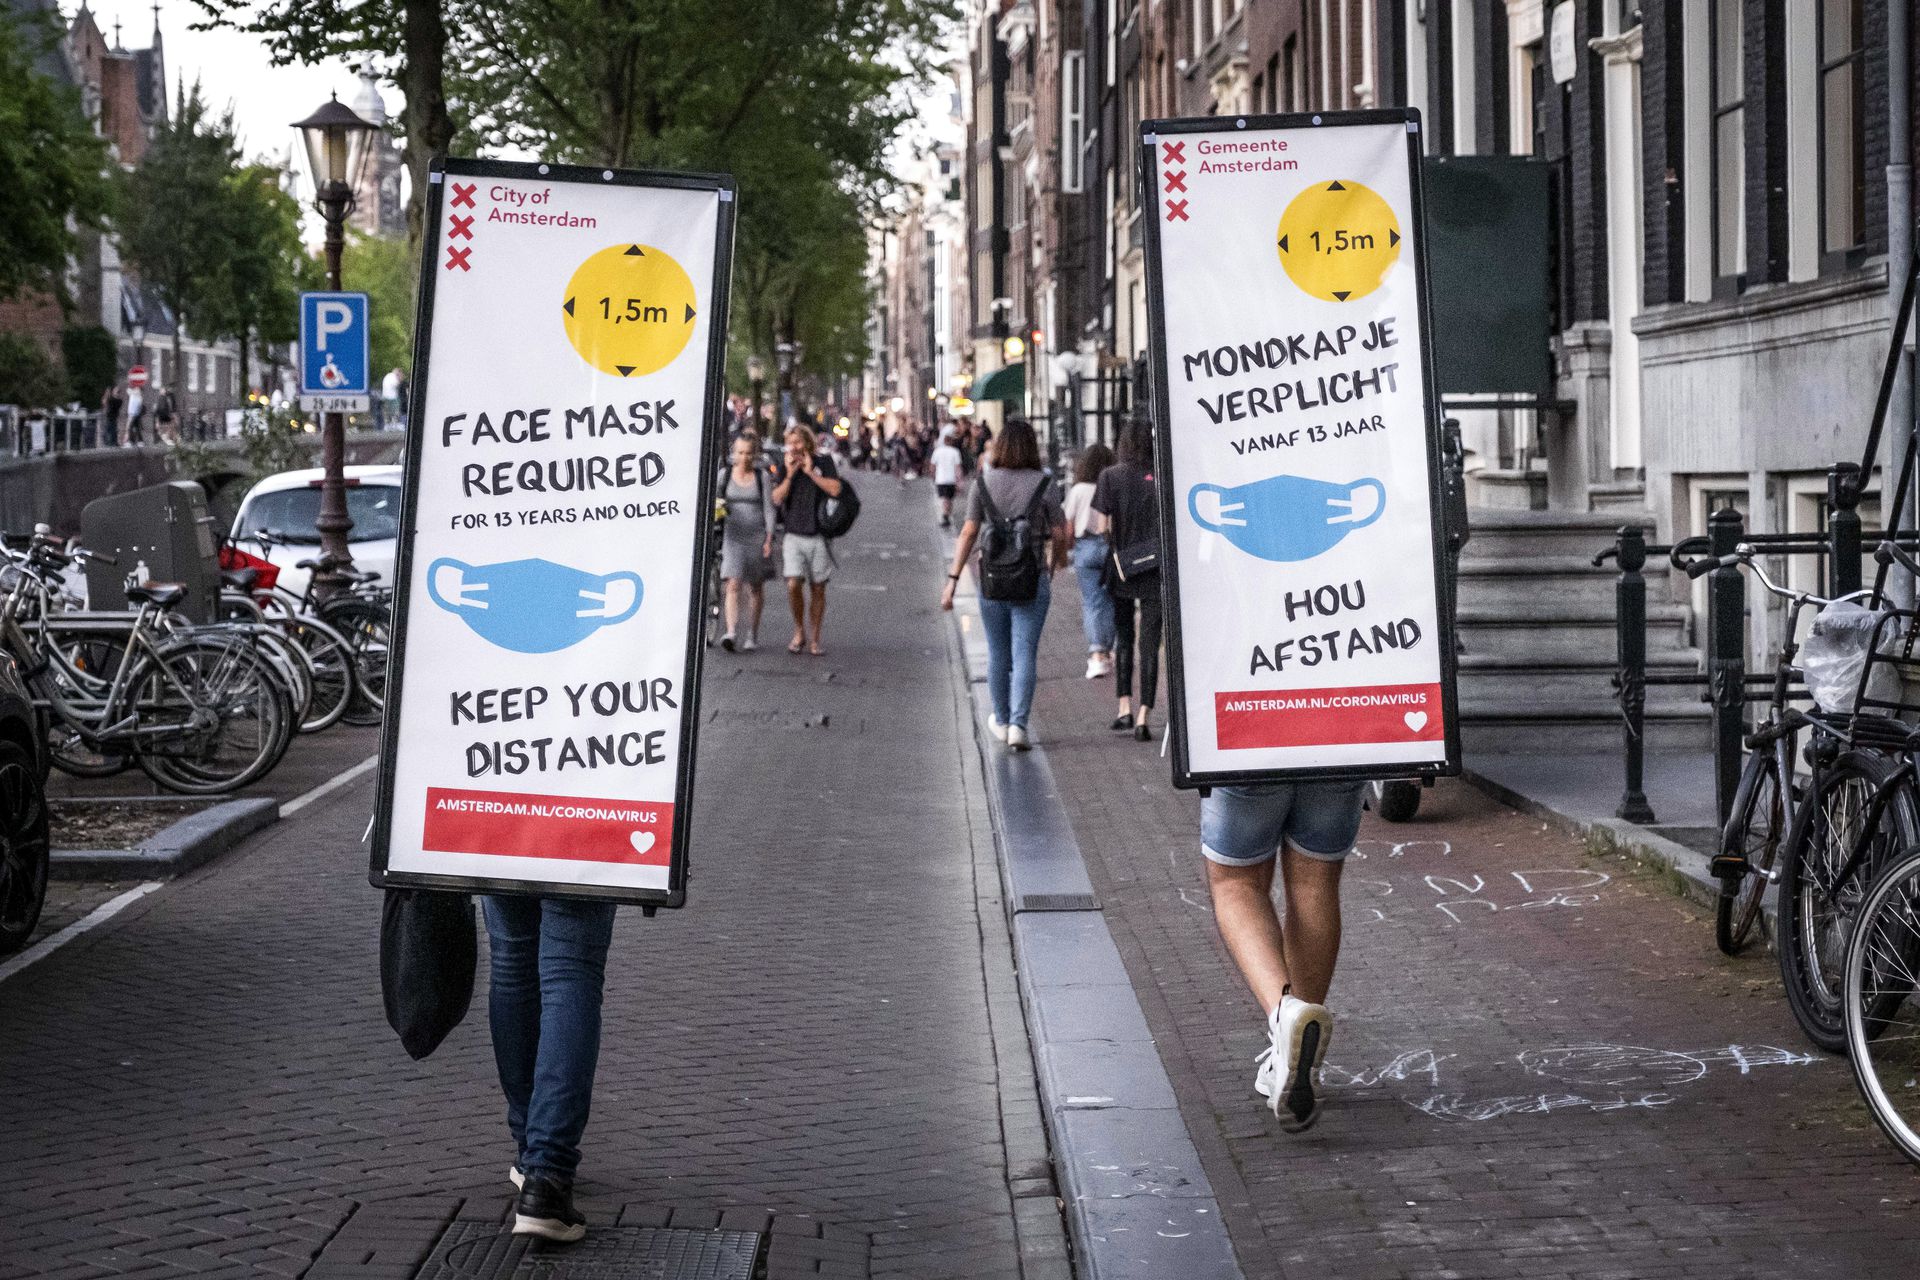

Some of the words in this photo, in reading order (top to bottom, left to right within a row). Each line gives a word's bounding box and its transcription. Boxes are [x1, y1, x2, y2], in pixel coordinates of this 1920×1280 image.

[1197, 138, 1288, 155] Gemeente
[1199, 157, 1298, 174] Amsterdam
[489, 185, 527, 207] City
[530, 187, 551, 205] of
[488, 207, 597, 229] Amsterdam
[1309, 230, 1374, 255] 1,5m
[317, 302, 352, 351] P
[599, 297, 668, 324] 1,5m
[1183, 317, 1398, 382] MONDKAPJE
[1197, 362, 1399, 425] VERPLICHT
[442, 407, 551, 448] FACE
[564, 399, 680, 440] MASK
[1230, 429, 1300, 455] VANAF
[1306, 425, 1328, 443] 13
[1333, 415, 1386, 438] JAAR
[461, 451, 666, 498] REQUIRED
[451, 513, 489, 530] FOR
[494, 511, 513, 527] 13
[517, 507, 578, 526] YEARS
[582, 504, 619, 522] AND
[623, 500, 681, 518] OLDER
[1283, 579, 1366, 623] HOU
[1250, 617, 1422, 676] AFSTAND
[449, 686, 549, 726] KEEP
[563, 677, 678, 718] YOUR
[1225, 692, 1427, 712] AMSTERDAM.NL/CORONAVIRUS
[465, 729, 667, 778] DISTANCE
[436, 798, 657, 824] AMSTERDAM.NL/CORONAVIRUS
